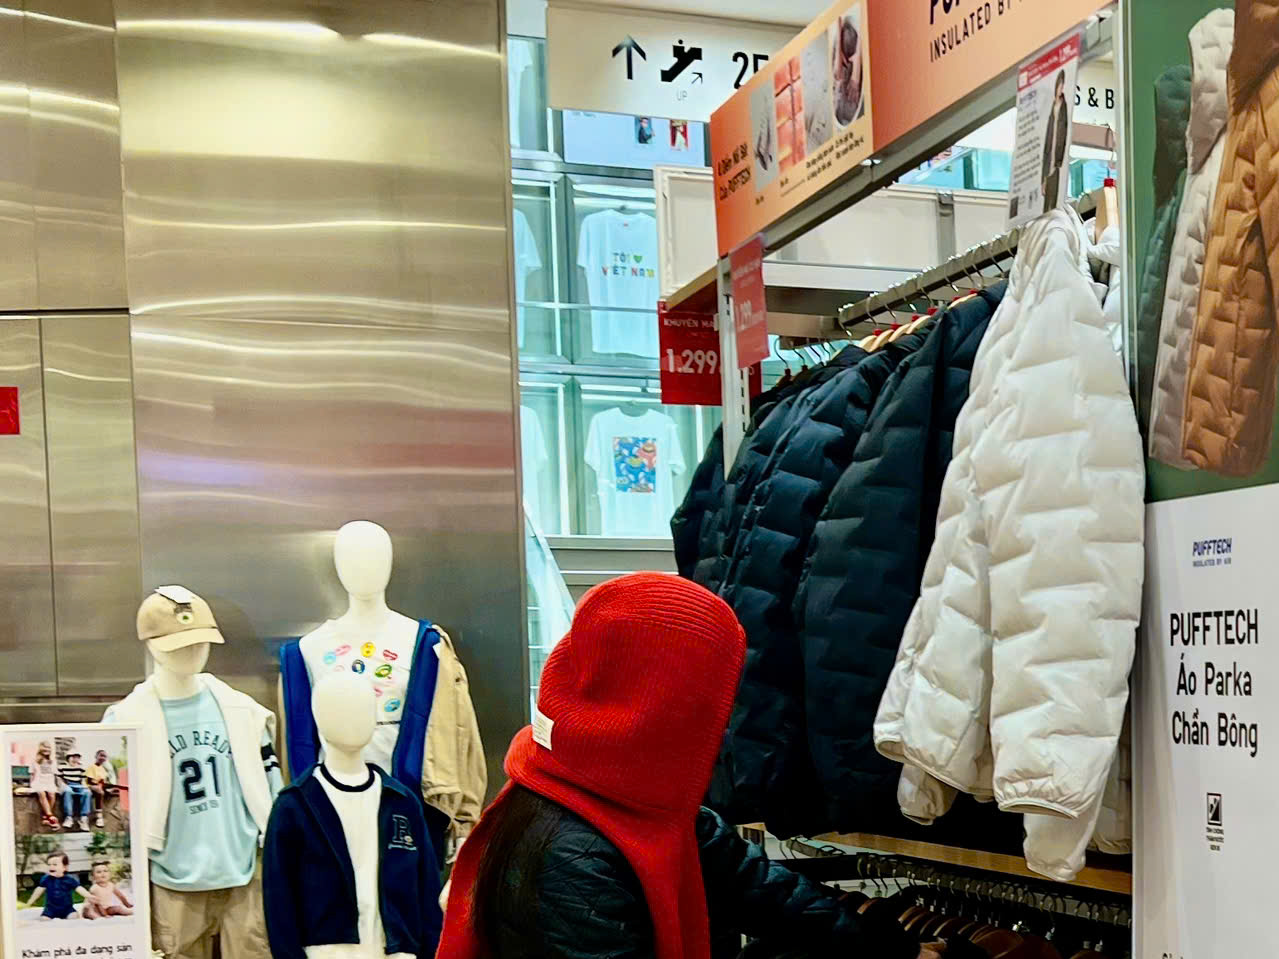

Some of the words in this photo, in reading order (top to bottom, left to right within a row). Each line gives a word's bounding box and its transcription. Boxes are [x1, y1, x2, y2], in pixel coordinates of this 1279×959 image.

[930, 2, 990, 62] INSULATED
[1170, 609, 1258, 646] PUFFTECH
[1176, 653, 1197, 695] Áo
[1205, 662, 1252, 696] Parka
[1218, 712, 1258, 757] Bông
[179, 754, 221, 803] 21
